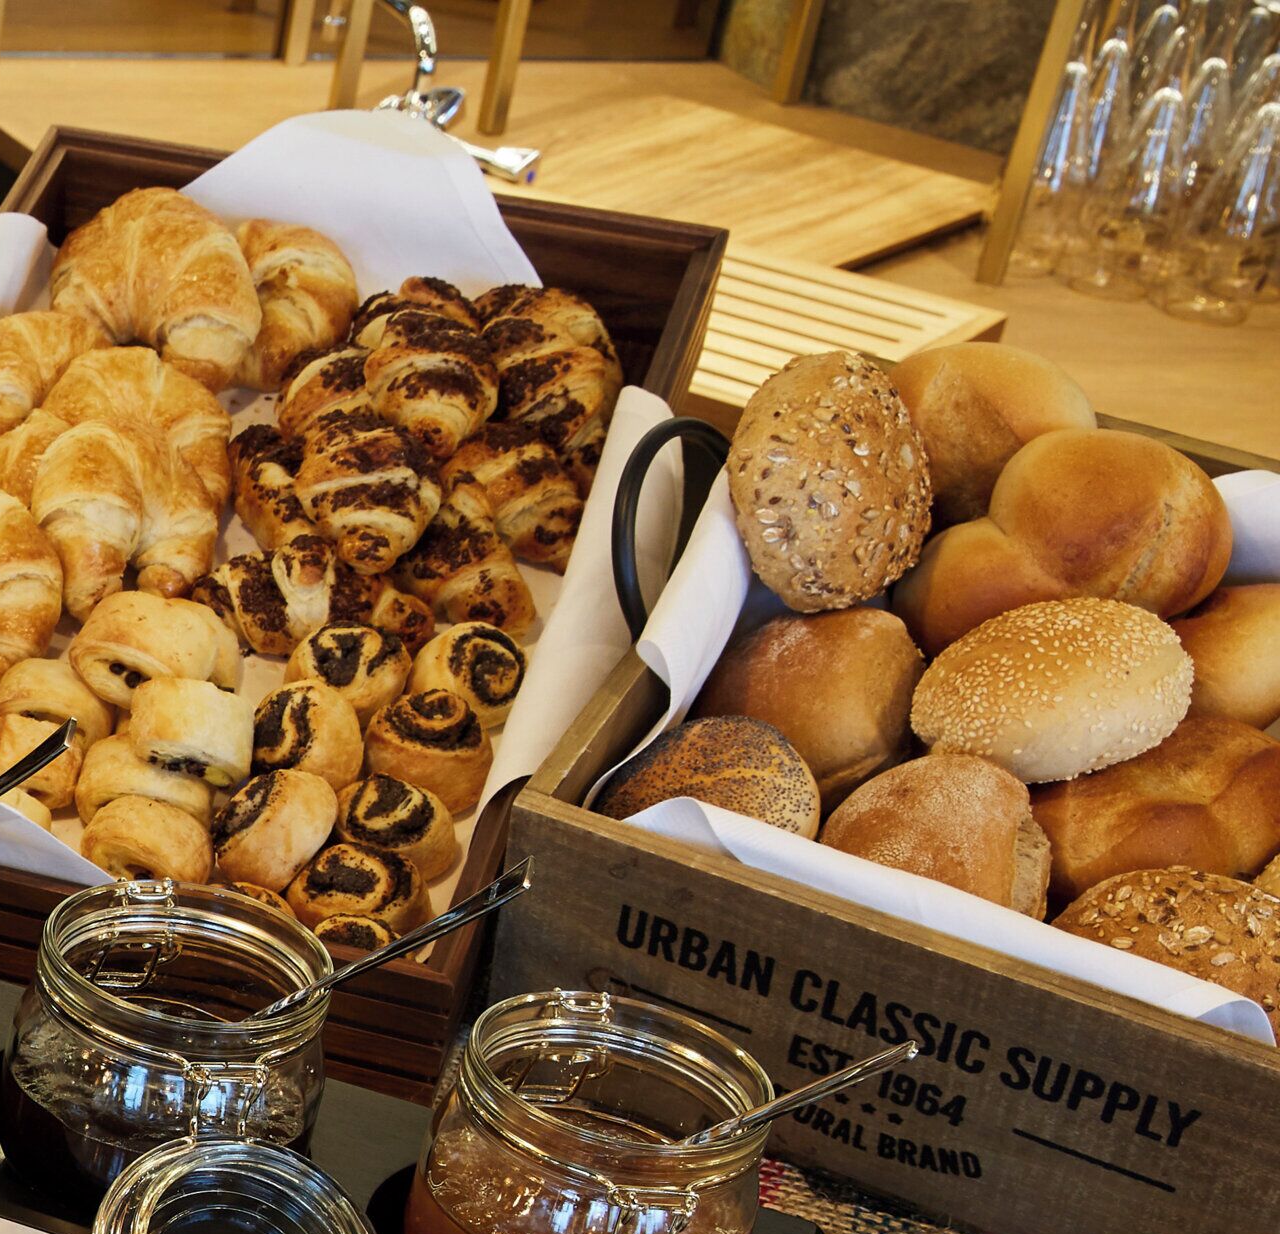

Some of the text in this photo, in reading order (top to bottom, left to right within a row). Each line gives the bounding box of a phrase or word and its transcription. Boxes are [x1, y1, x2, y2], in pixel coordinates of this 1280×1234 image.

[616, 904, 1202, 1147] URBAN CLASSIC SUPPLY
[878, 1070, 967, 1127] 1964
[877, 1132, 982, 1179] BRAND
